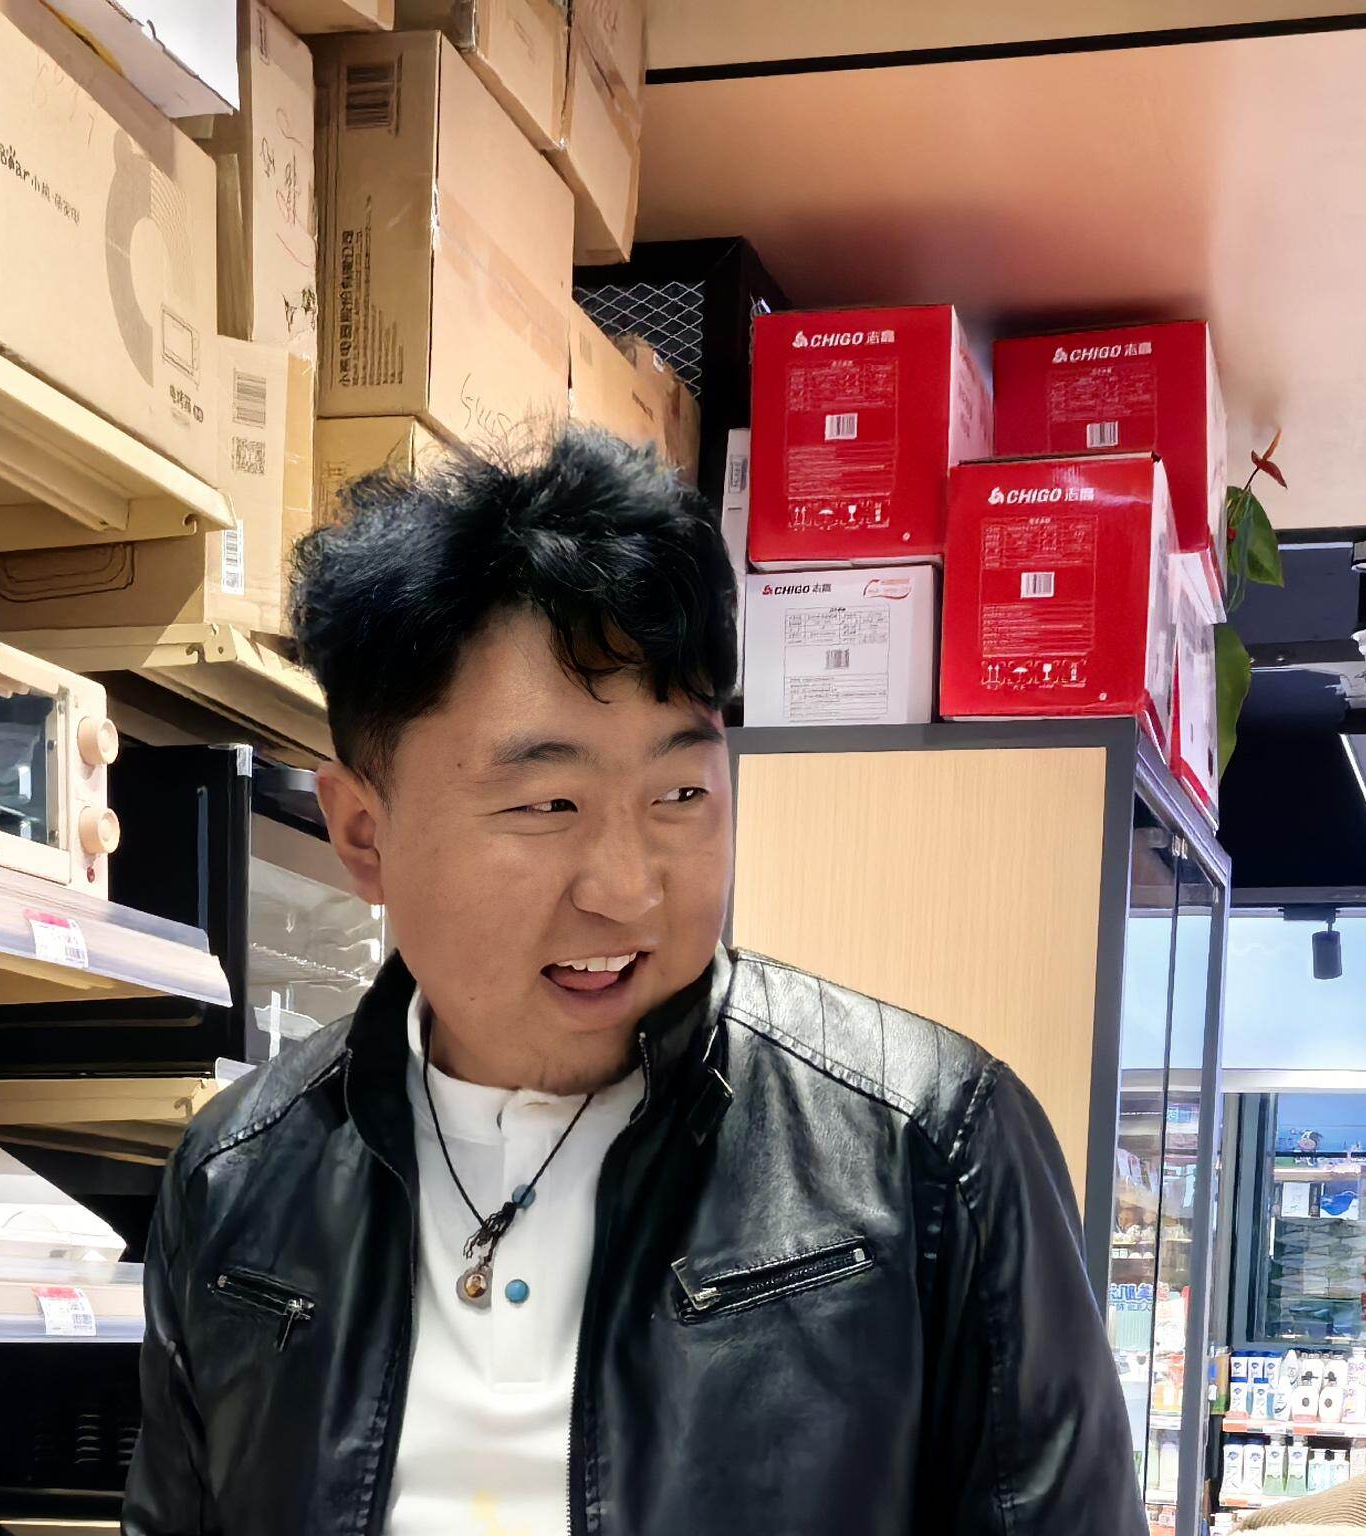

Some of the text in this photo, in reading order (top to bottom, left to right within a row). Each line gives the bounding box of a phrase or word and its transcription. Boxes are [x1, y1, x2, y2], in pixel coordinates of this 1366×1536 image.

[809, 331, 864, 348] CHIGO
[1069, 344, 1122, 362] CHIGO
[1006, 487, 1062, 505] CHIGO
[774, 584, 811, 596] CHIGO
